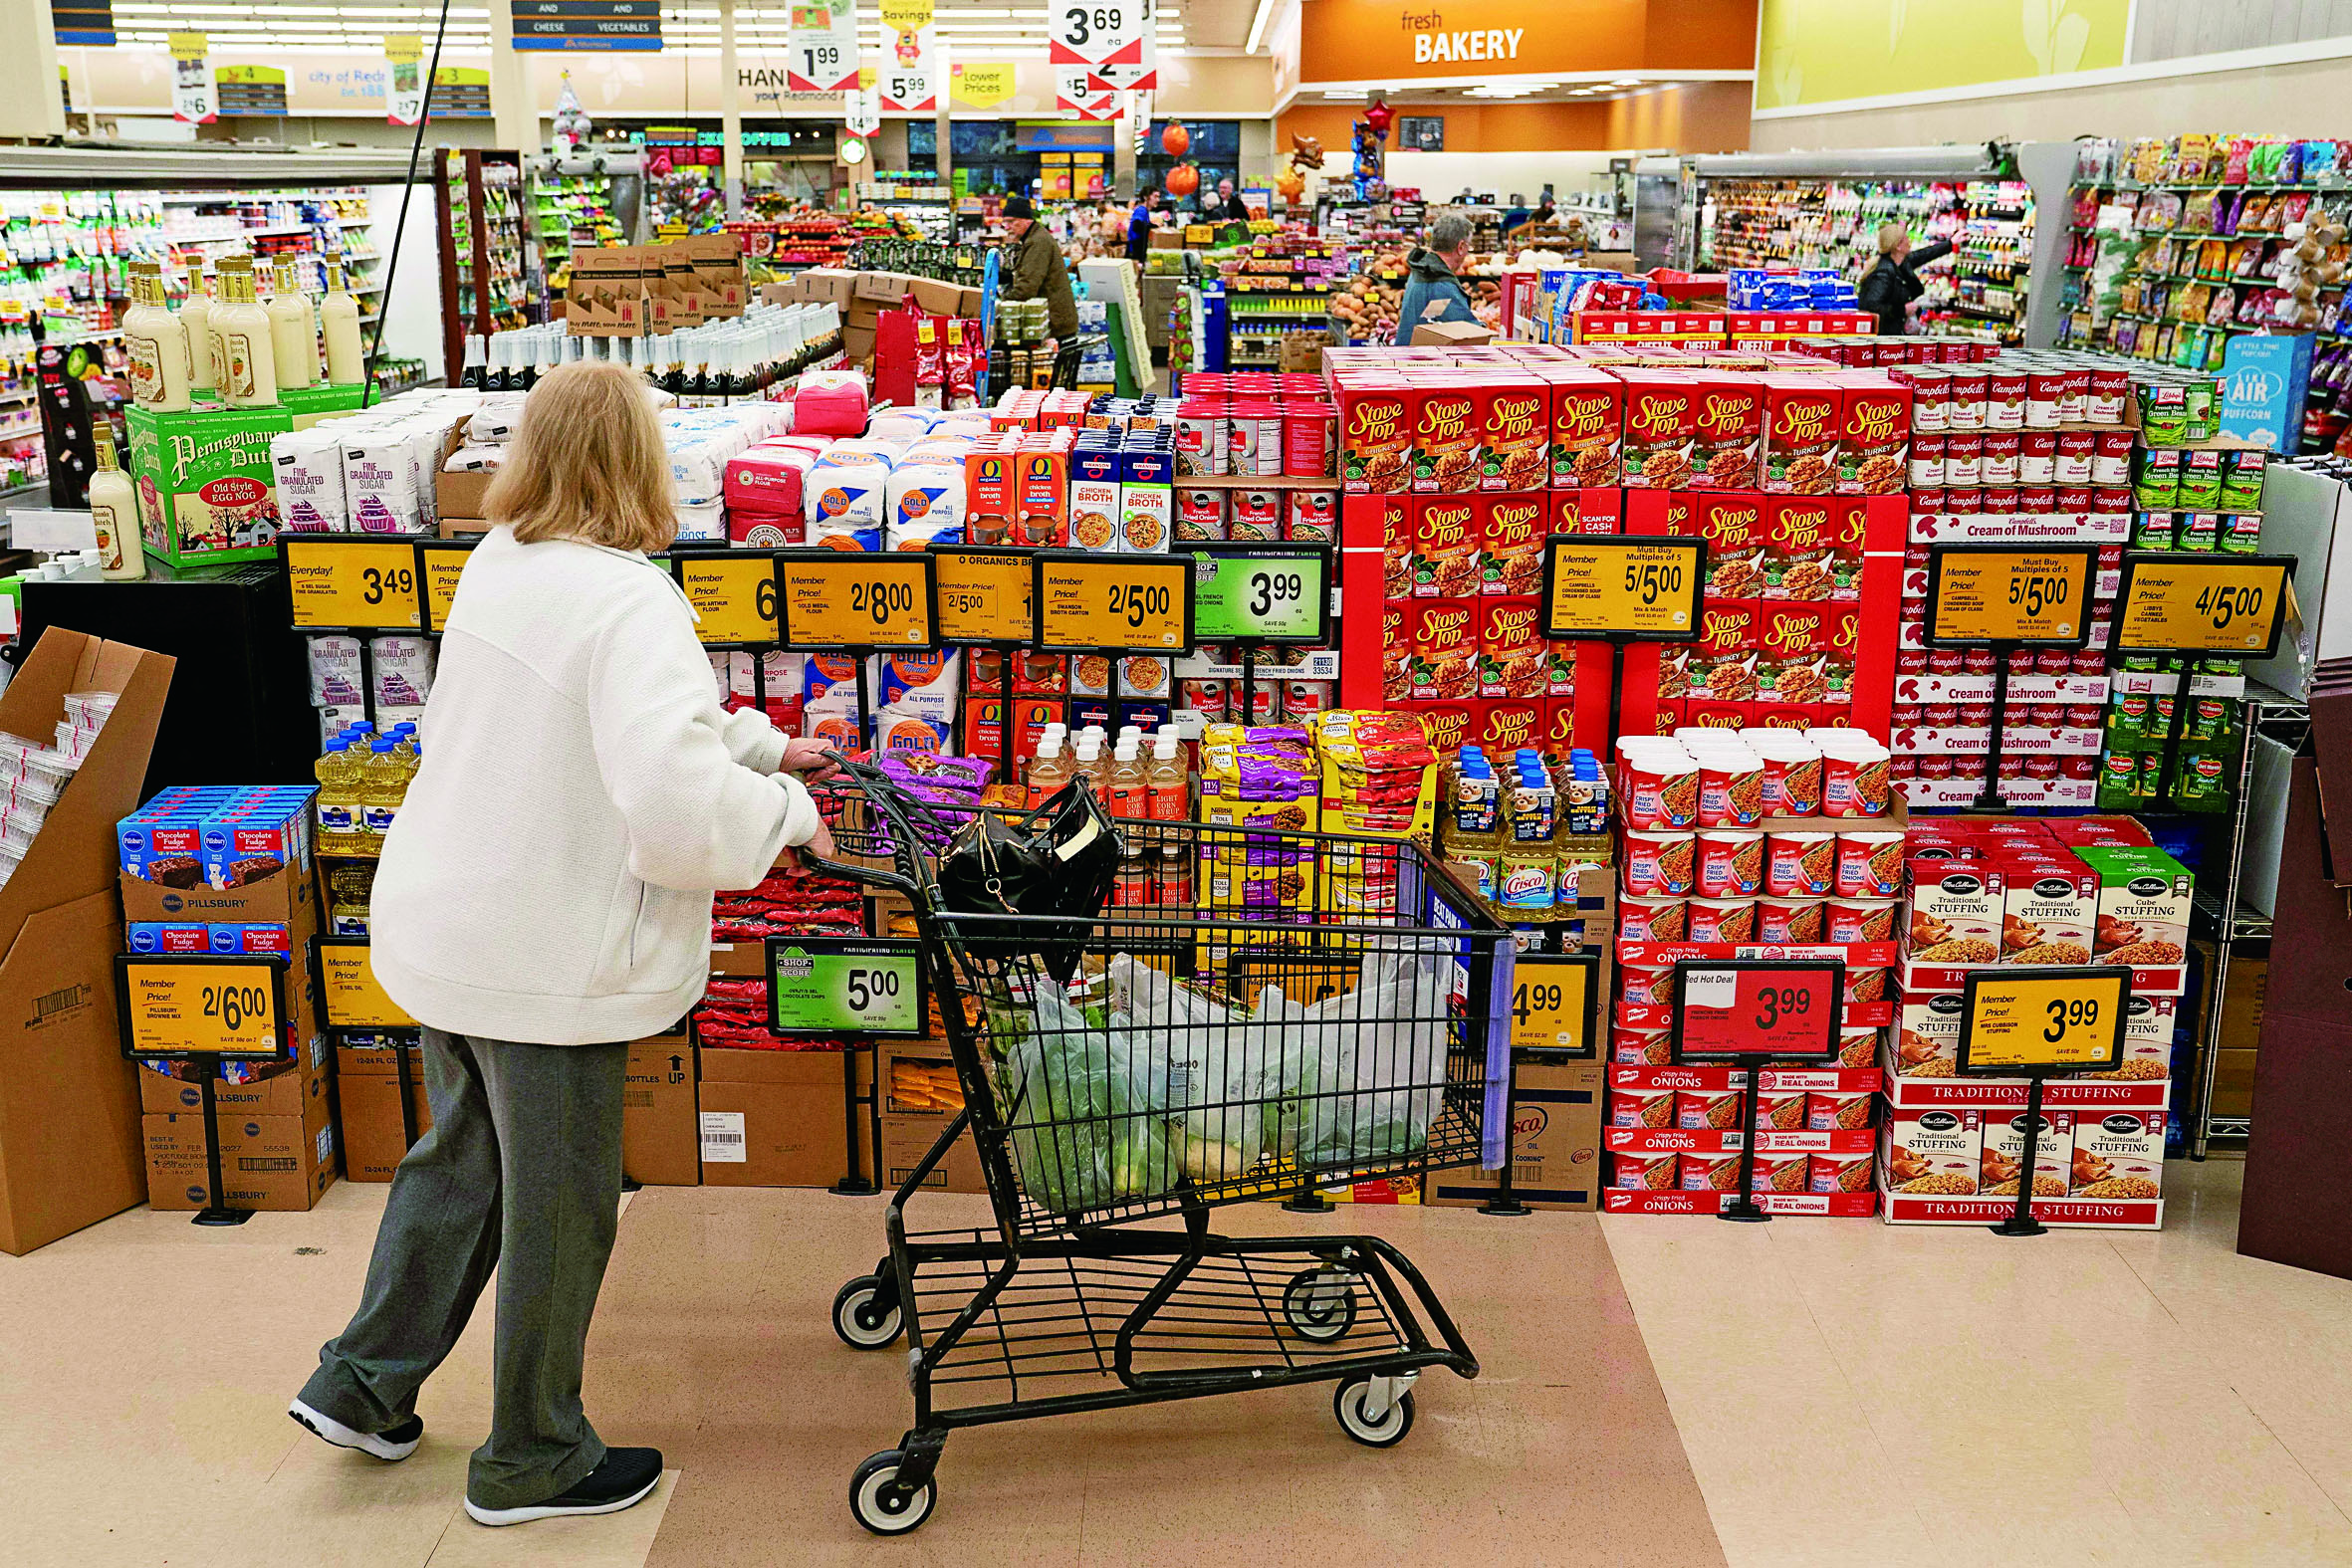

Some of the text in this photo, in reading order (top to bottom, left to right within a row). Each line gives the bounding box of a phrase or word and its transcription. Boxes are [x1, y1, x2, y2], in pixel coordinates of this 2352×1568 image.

[539, 4, 558, 14] AND
[613, 4, 632, 14] AND
[882, 11, 931, 23] Savings
[1400, 10, 1442, 31] fresh
[534, 22, 565, 33] CHEESE
[597, 22, 649, 33] VEGETABLES
[1414, 28, 1524, 64] BAKERY
[244, 67, 255, 80] 4
[309, 71, 331, 85] city
[450, 68, 459, 82] 3
[963, 72, 1001, 83] Lower
[963, 83, 1001, 94] Prices
[755, 90, 837, 104] your Redmond
[629, 131, 792, 146] STCKS OFFEE
[2232, 382, 2268, 402] AIR
[1348, 400, 1404, 443] Stove Top
[1364, 443, 1397, 457] CHICKEN
[1649, 438, 1678, 451] TURKEY
[362, 462, 377, 472] FINE
[350, 470, 393, 481] GRANULATED
[212, 482, 253, 496] Old Style
[358, 479, 385, 490] SUGAR
[211, 490, 256, 503] EGG NOG
[823, 495, 846, 506] GOLD
[1077, 494, 1113, 503] BROTH
[1585, 522, 1613, 531] CASH
[1967, 525, 2077, 537] Cream of Mushroom
[1626, 553, 1665, 561] Multiples
[1657, 547, 1673, 556] Buy
[958, 556, 1019, 566] O ORGANICS
[289, 564, 334, 577] Everyday!
[687, 574, 724, 583] Member
[791, 576, 826, 585] Member
[694, 586, 719, 595] Price!
[937, 581, 971, 590] Member
[797, 589, 822, 598] Price!
[123, 836, 144, 845] Pillsbury
[1507, 874, 1542, 894] Crisco
[187, 898, 246, 908] PILLSBURY
[1938, 896, 1982, 905] Traditional
[2135, 898, 2157, 907] Cube
[1929, 903, 1990, 914] STUFFING
[781, 969, 811, 978] SCORE
[1715, 975, 1734, 984] Deal
[668, 1072, 685, 1085] UP
[1660, 1070, 1678, 1080] Crispy
